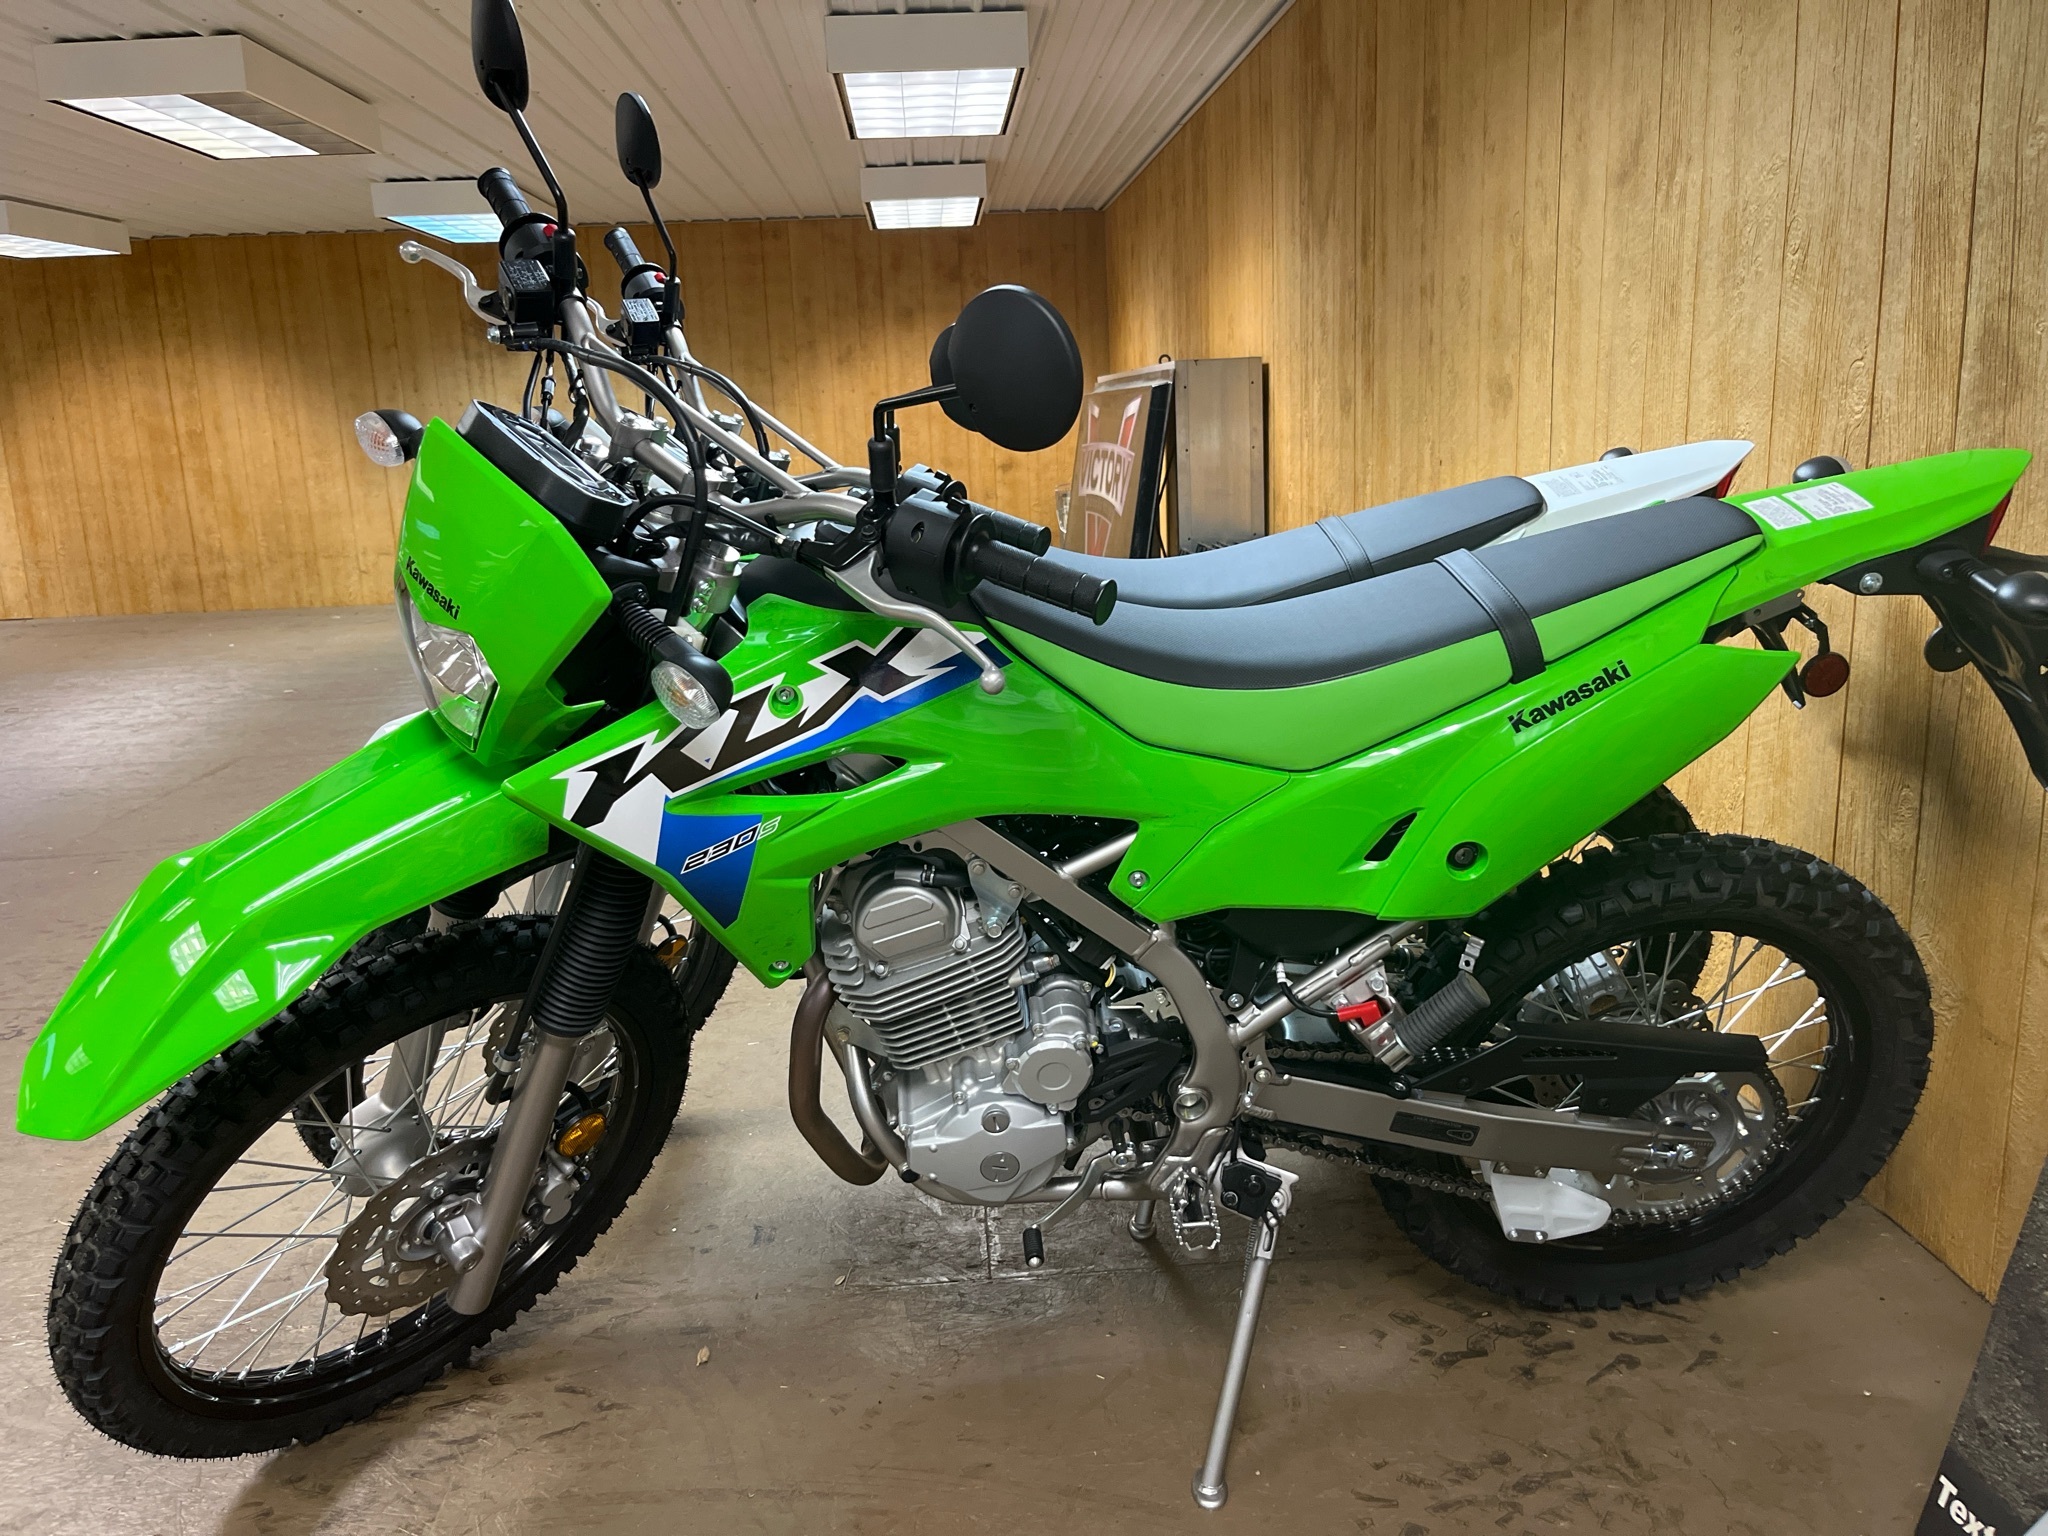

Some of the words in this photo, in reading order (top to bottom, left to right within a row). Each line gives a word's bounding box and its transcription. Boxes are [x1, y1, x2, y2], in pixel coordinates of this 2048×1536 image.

[1081, 447, 1133, 503] VICTORY
[405, 555, 461, 620] Kawasaki
[560, 624, 946, 830] KLX
[1507, 659, 1632, 734] Kawasaki
[680, 815, 782, 875] 230S
